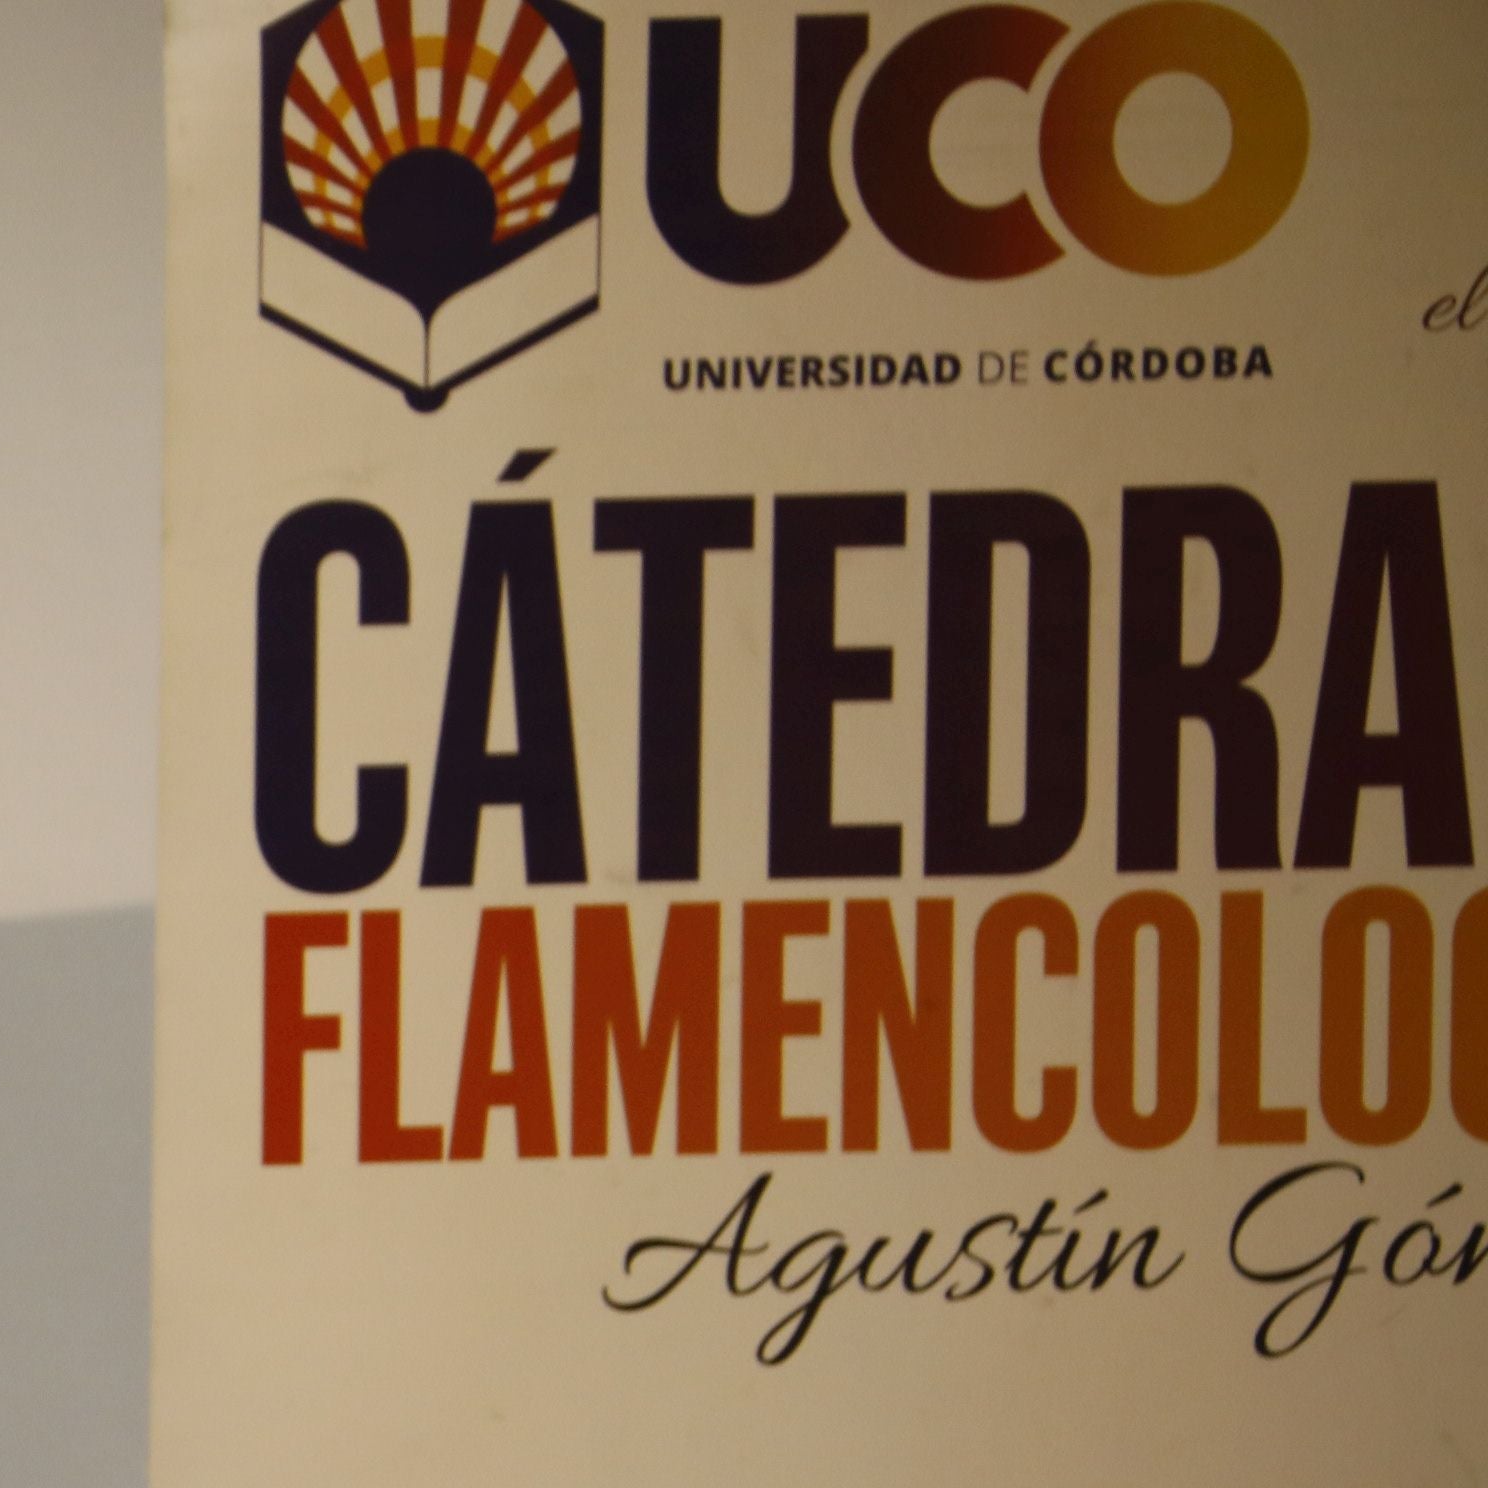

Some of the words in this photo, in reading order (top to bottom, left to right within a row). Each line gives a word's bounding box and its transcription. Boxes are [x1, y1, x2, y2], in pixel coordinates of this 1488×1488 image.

[645, 1, 1310, 286] UCO
[663, 353, 962, 391] UNIVERSIDAD
[977, 350, 1028, 386] DE
[1043, 340, 1274, 382] CÓRDOBA
[254, 449, 1476, 894] CÁTEDRA
[602, 1172, 1186, 1366] Agustín
